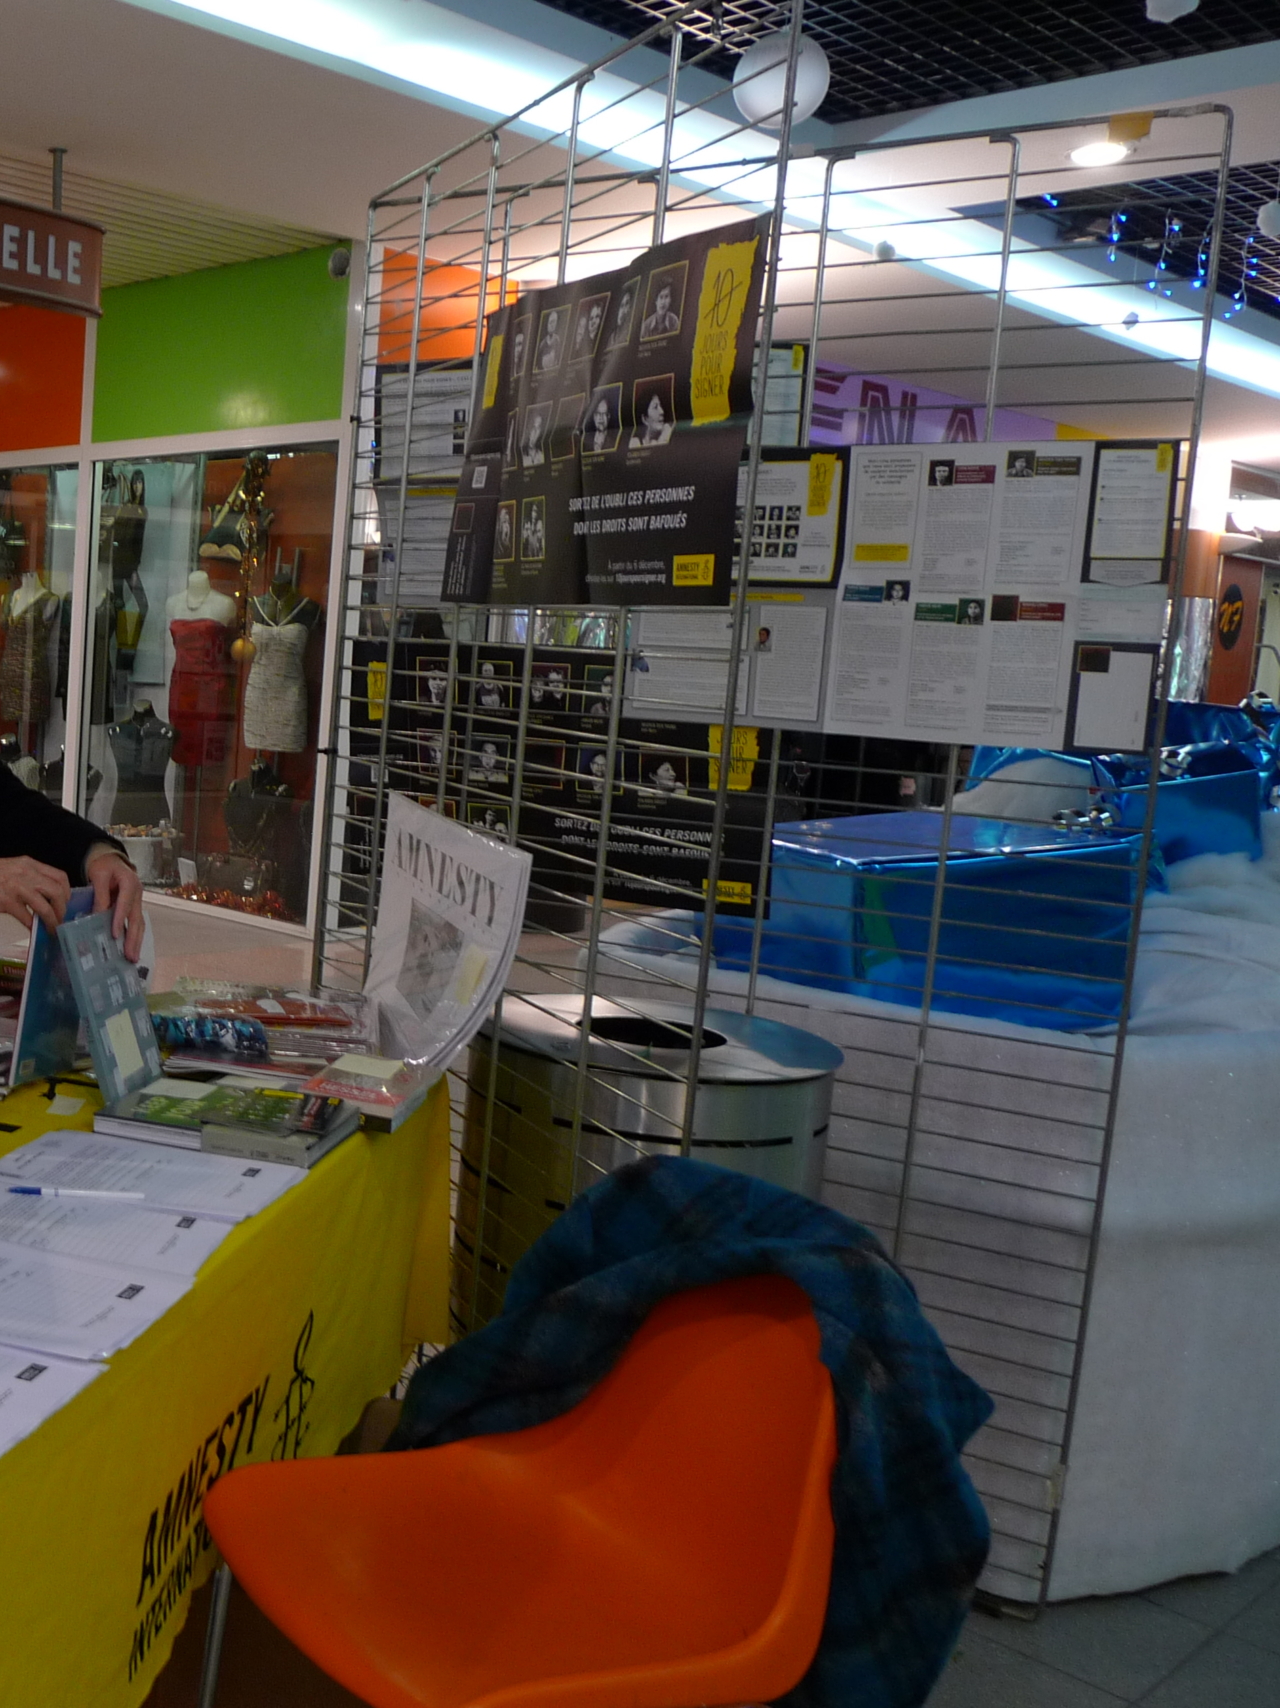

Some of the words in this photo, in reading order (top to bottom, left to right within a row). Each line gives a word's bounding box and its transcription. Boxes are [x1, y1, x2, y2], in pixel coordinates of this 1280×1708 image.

[627, 490, 644, 507] CES
[644, 485, 696, 505] PERSONNES
[627, 516, 650, 532] SONT
[649, 510, 688, 530] BAFOUÉS
[554, 817, 588, 831] SORTEZ
[392, 827, 505, 929] AMNESTY
